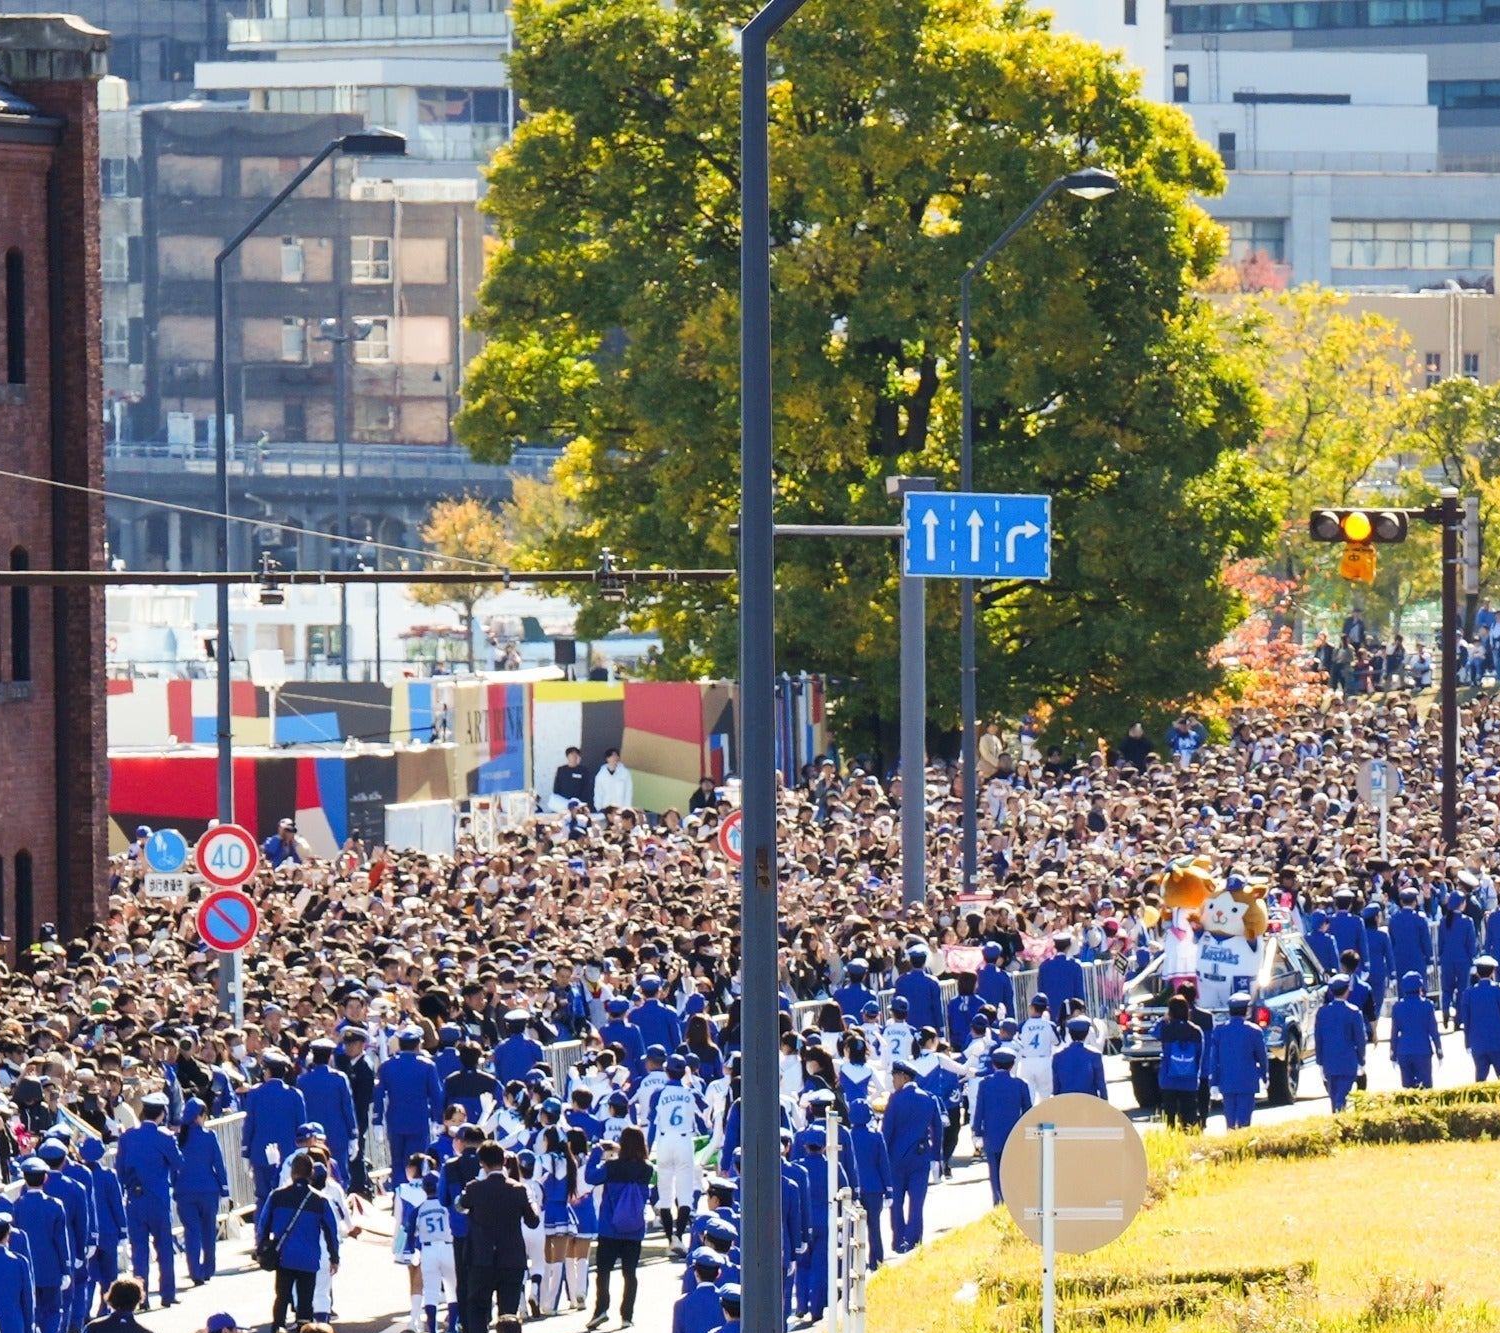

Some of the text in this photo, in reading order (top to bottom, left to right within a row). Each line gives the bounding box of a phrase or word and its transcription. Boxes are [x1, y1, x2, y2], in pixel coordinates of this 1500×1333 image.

[211, 843, 244, 869] 40
[1029, 1033, 1041, 1049] 4
[669, 1106, 684, 1127] 6
[425, 1217, 444, 1234] 51
